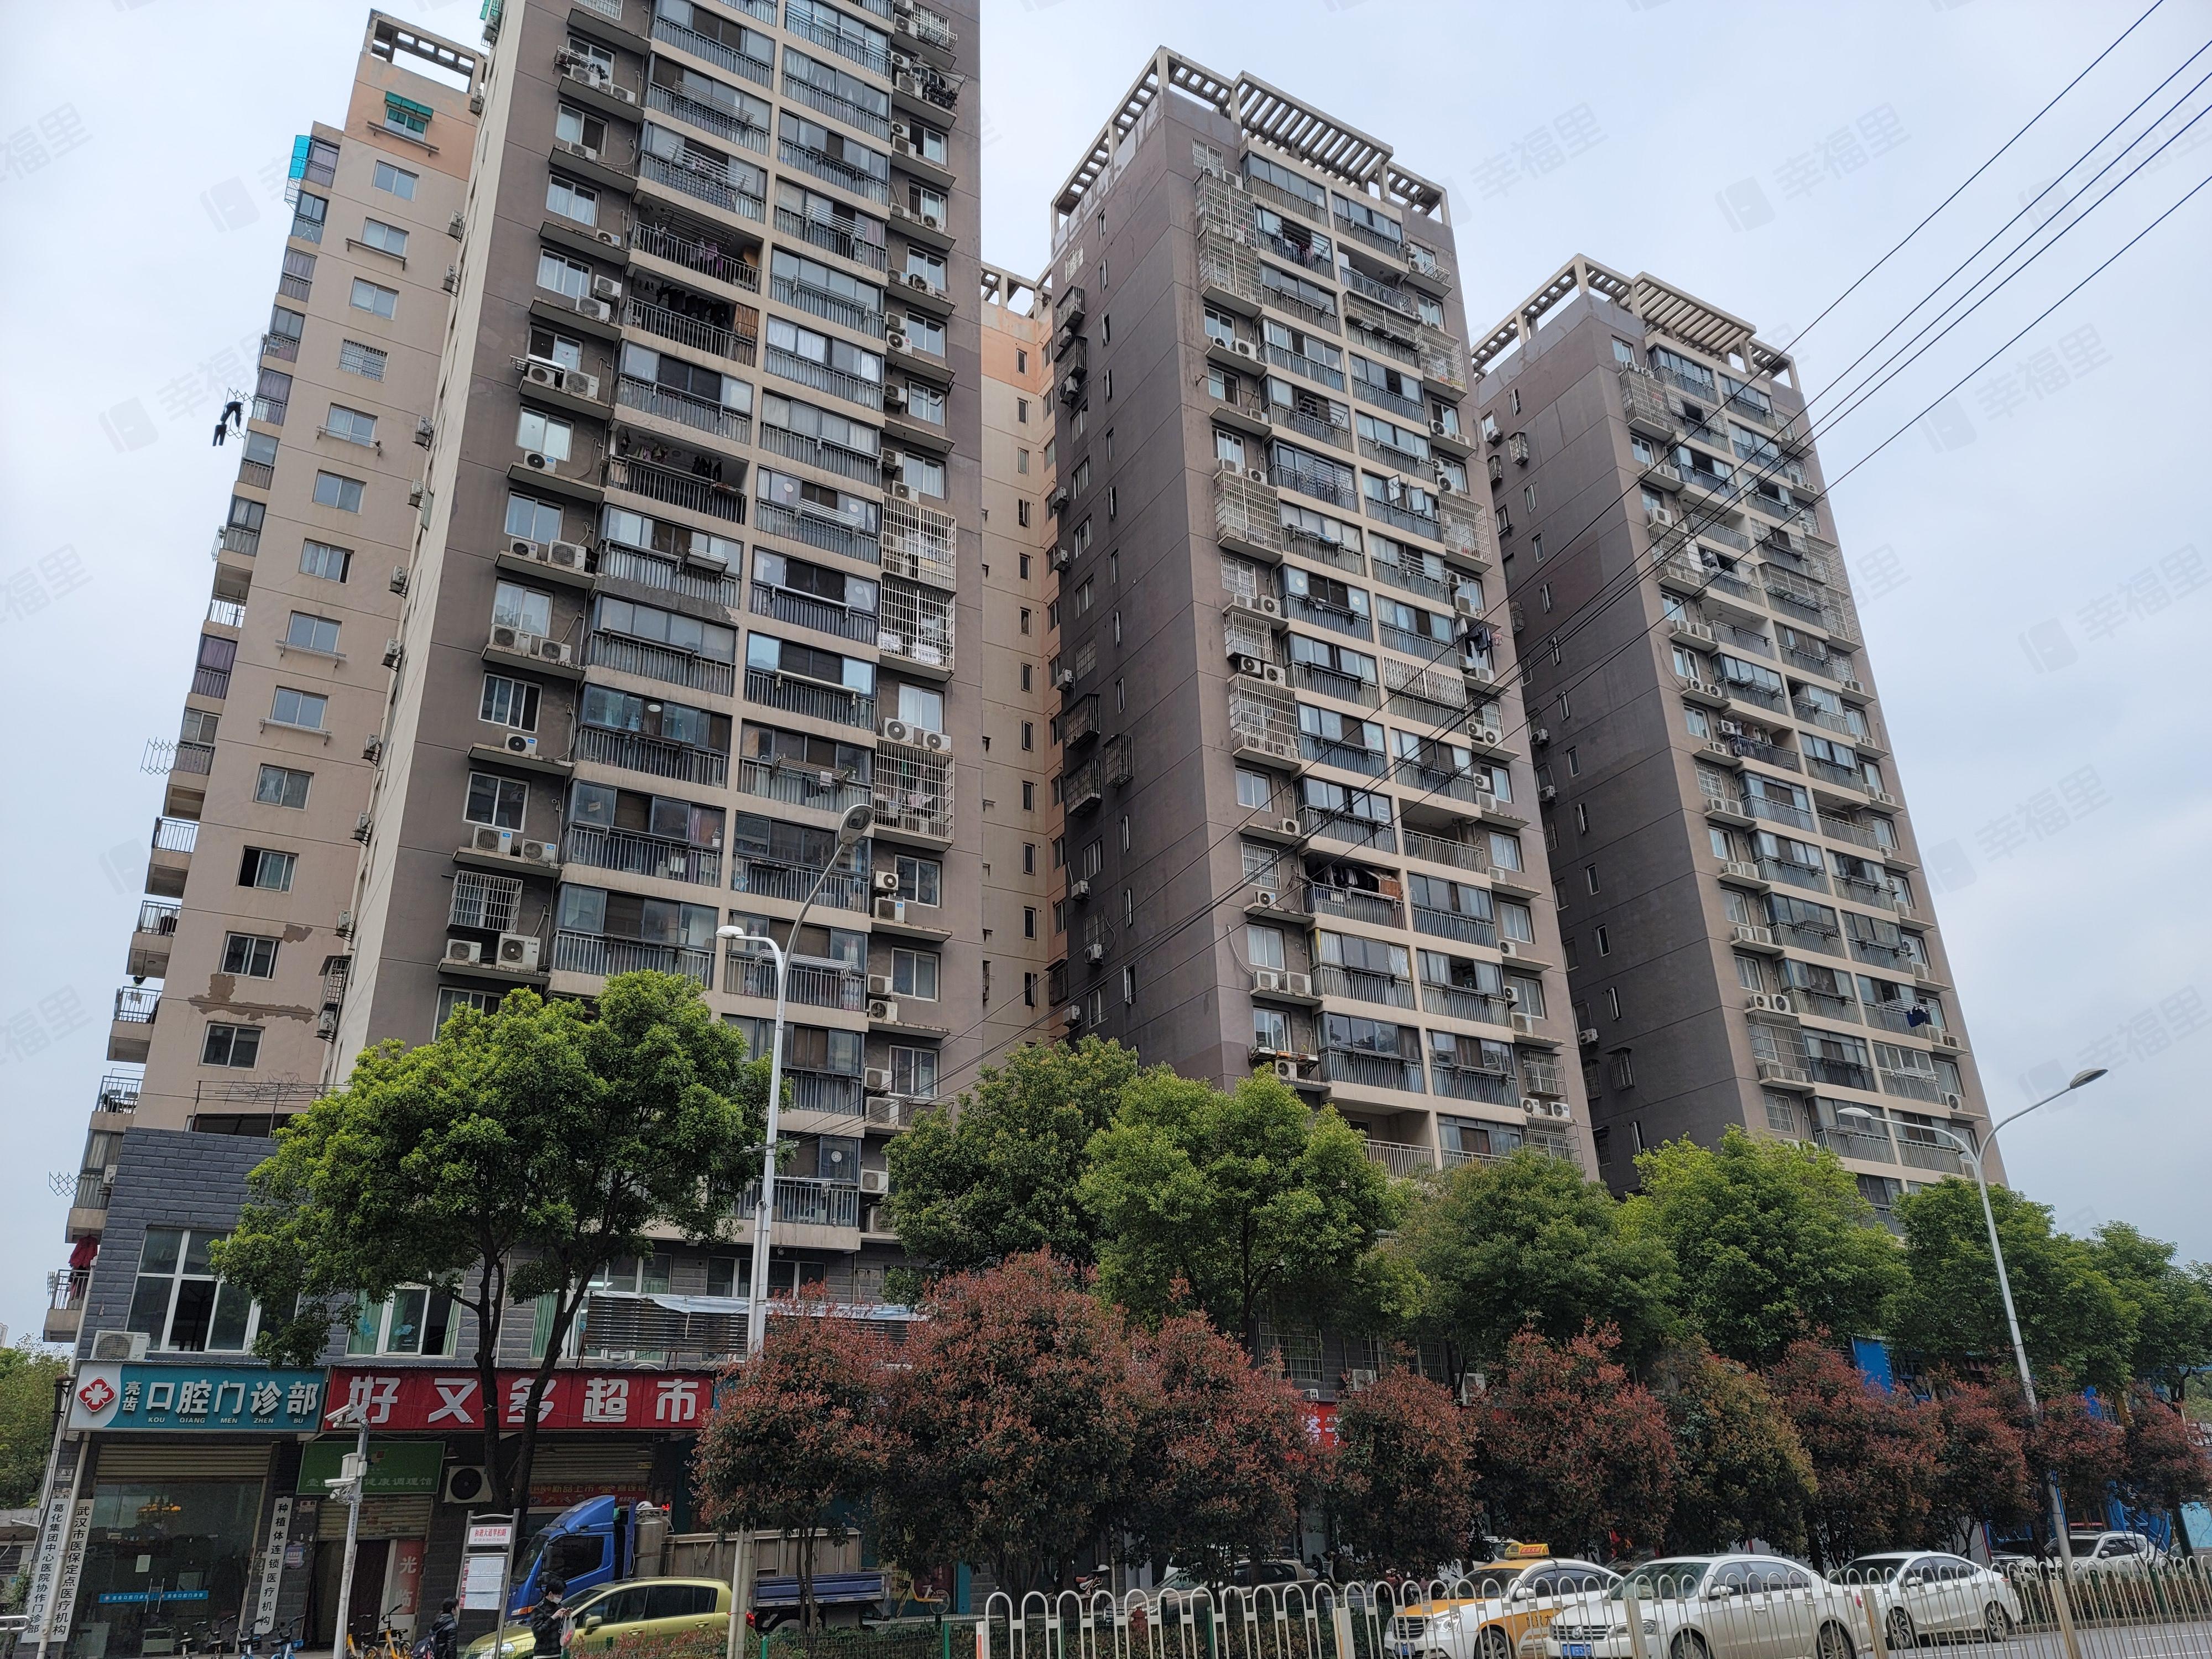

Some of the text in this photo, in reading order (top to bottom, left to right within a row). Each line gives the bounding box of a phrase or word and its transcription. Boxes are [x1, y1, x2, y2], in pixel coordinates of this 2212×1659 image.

[122, 1379, 320, 1416] 亮齿 口腔门诊部
[348, 1376, 700, 1425] 好又多超市
[27, 1503, 64, 1634] 葛化集团中心医院协作门诊部
[52, 1506, 91, 1636] 武汉市医保定点医疗机构
[259, 1503, 289, 1626] 种植体连锁医疗机构
[395, 1555, 418, 1608] 光临
